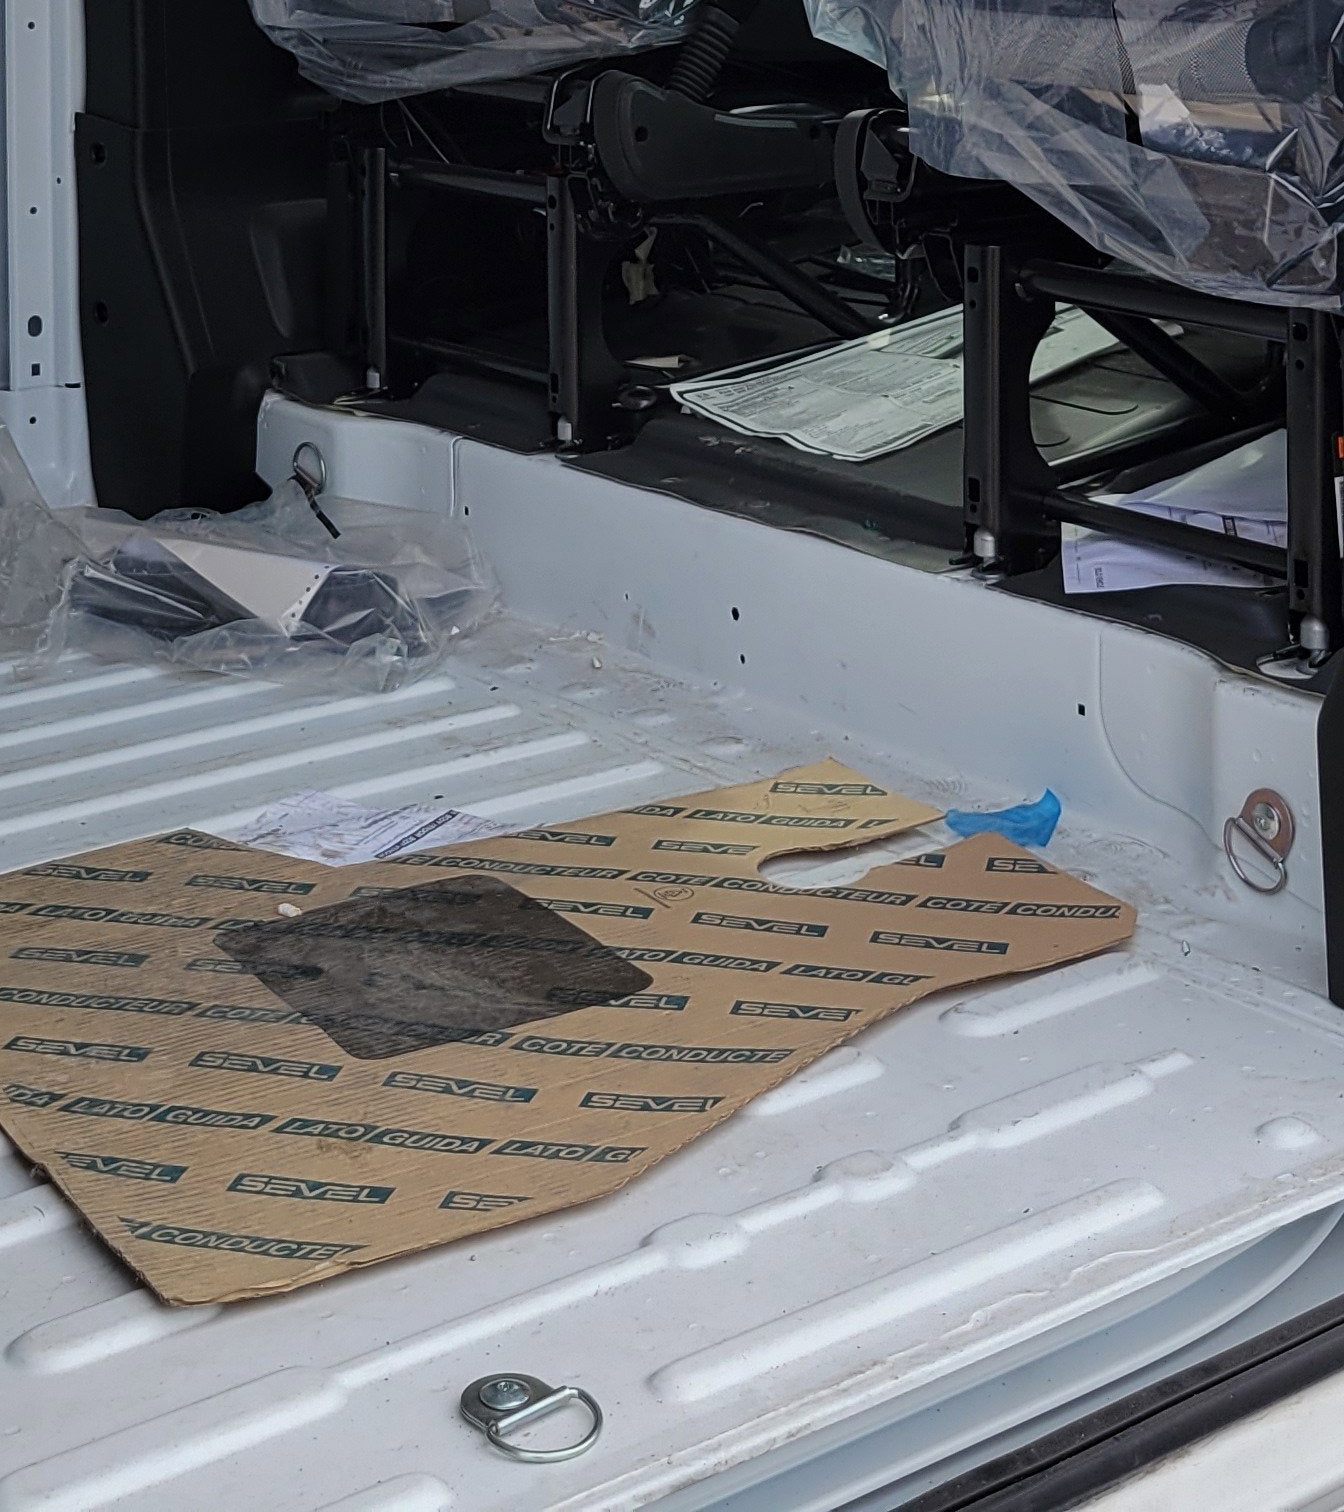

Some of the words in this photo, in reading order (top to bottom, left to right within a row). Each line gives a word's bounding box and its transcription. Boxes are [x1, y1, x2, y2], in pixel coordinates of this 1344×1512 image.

[775, 783, 885, 795] SEVEL
[696, 810, 754, 823] LATO
[770, 816, 845, 829] GUIDA
[659, 840, 753, 855] SEVE
[697, 913, 819, 937] SEVEL
[877, 933, 1003, 953] SEVEL
[20, 947, 137, 966] SEVEL
[616, 949, 666, 961] ATO
[683, 954, 769, 972] GUIDA
[791, 965, 864, 980] LATO
[738, 1002, 852, 1020] SEVE
[622, 1045, 792, 1062] CONDUCTE
[11, 1038, 138, 1062] SEVEL
[197, 1051, 331, 1080] SEVEL
[390, 1072, 527, 1102] SEVEL
[77, 1100, 152, 1118] LATO
[167, 1110, 261, 1128] GUIDA
[285, 1121, 367, 1138] LATO
[383, 1132, 480, 1152] GUIDA
[505, 1142, 587, 1159] LATO
[236, 1176, 381, 1201] SEVEL
[151, 1228, 347, 1259] CONDUCTE
